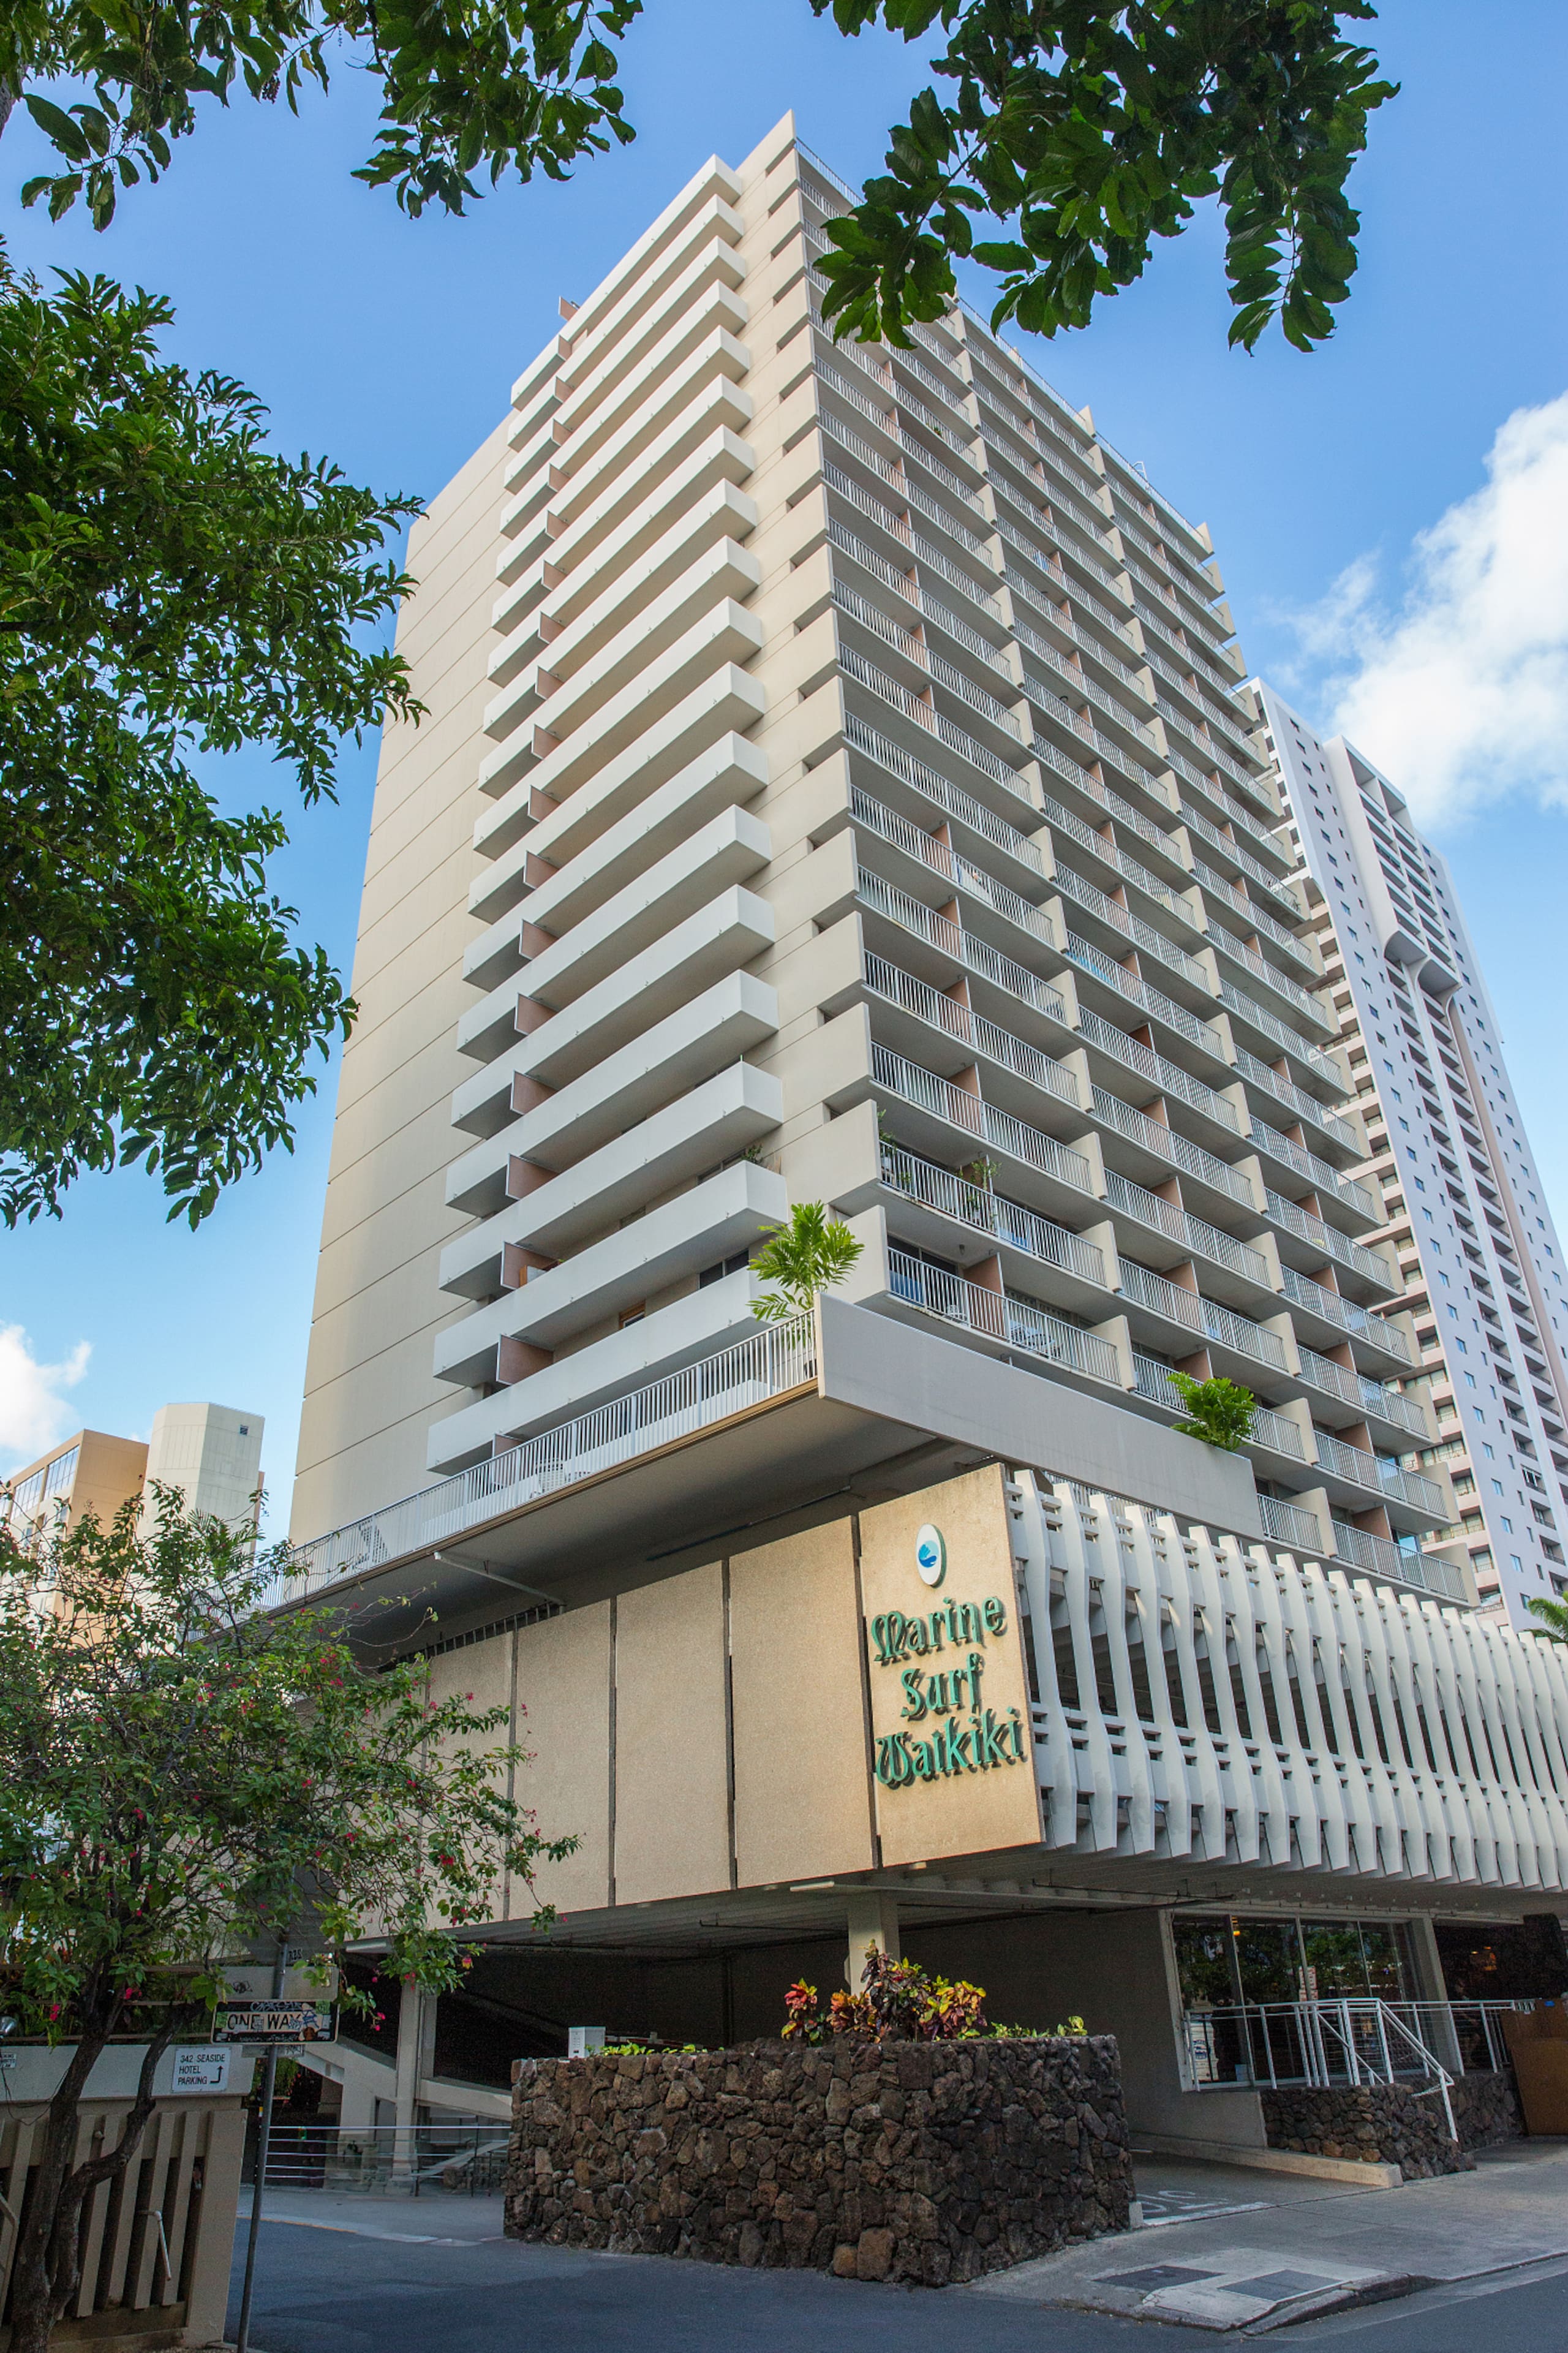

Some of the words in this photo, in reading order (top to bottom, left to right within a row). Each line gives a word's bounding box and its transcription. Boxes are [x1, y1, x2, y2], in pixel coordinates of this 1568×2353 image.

[871, 1596, 1005, 1663] Marine
[900, 1652, 983, 1720] Surf
[875, 1707, 1025, 1786] Waikiki
[227, 2013, 263, 2030] ONE
[267, 2013, 303, 2030] WAY
[178, 2076, 207, 2086] PARKING
[179, 2066, 201, 2074] HOTEL
